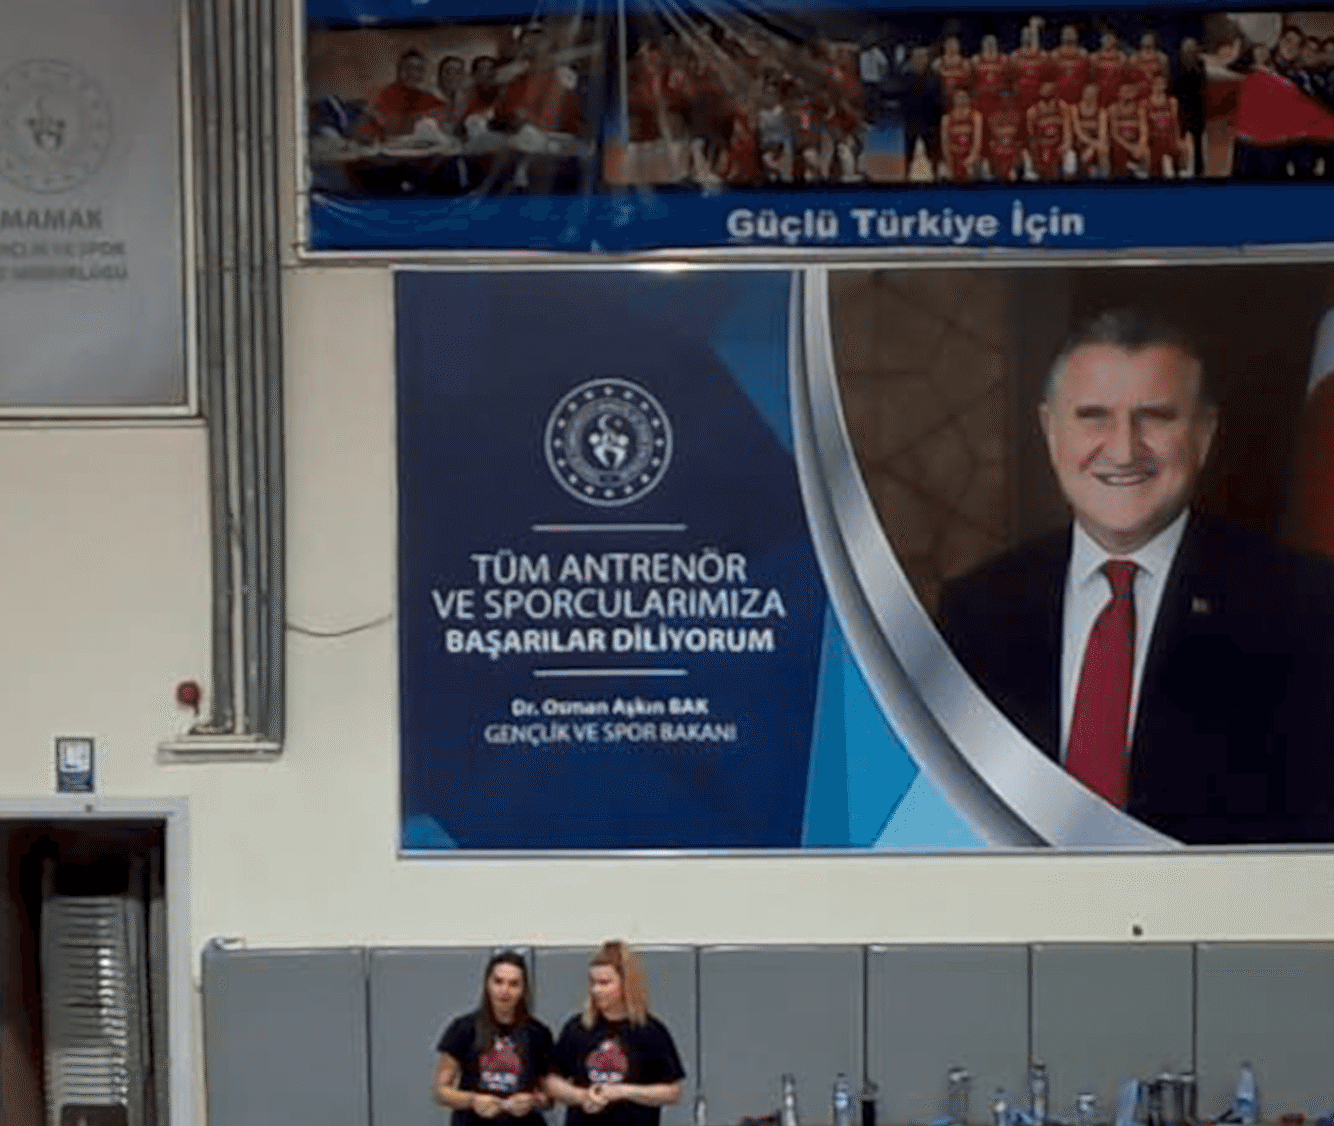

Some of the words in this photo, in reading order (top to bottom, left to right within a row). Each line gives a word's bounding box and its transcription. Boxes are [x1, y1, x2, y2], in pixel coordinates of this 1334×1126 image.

[0, 208, 103, 230] MAMAK
[726, 207, 839, 245] Güçlü
[850, 207, 1000, 245] Türkiye
[1011, 198, 1086, 244] İçin
[470, 549, 551, 584] TÜM
[558, 547, 748, 584] ANTRENÖR
[431, 588, 475, 619] VE
[484, 588, 787, 619] SPORCULARIMIZA
[445, 628, 607, 660] BAŞARILAR
[612, 622, 775, 652] DİLİYORUM
[511, 697, 540, 716] Dr.
[542, 697, 609, 716] Osman
[612, 696, 665, 719] Aşkın
[668, 697, 710, 715] BAK
[484, 721, 570, 748] GENÇLİK
[572, 722, 599, 743] VE
[602, 722, 657, 743] SPOR
[660, 721, 738, 743] BAKANI
